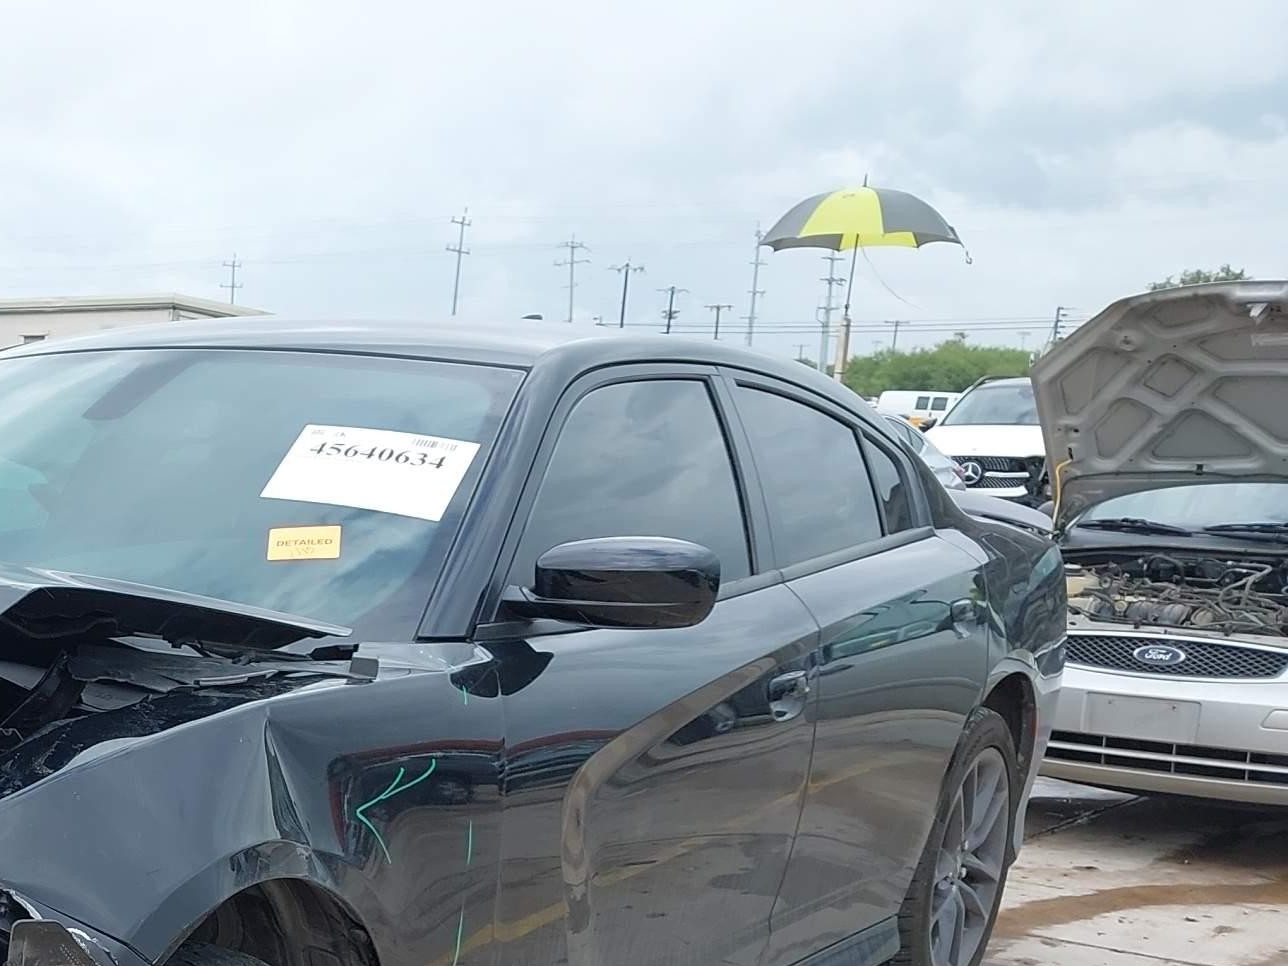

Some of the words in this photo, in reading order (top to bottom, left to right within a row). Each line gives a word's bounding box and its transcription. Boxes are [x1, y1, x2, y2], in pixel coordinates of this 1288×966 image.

[309, 441, 447, 470] 45640634
[275, 538, 334, 548] DETAILED
[1145, 649, 1173, 661] Ford
